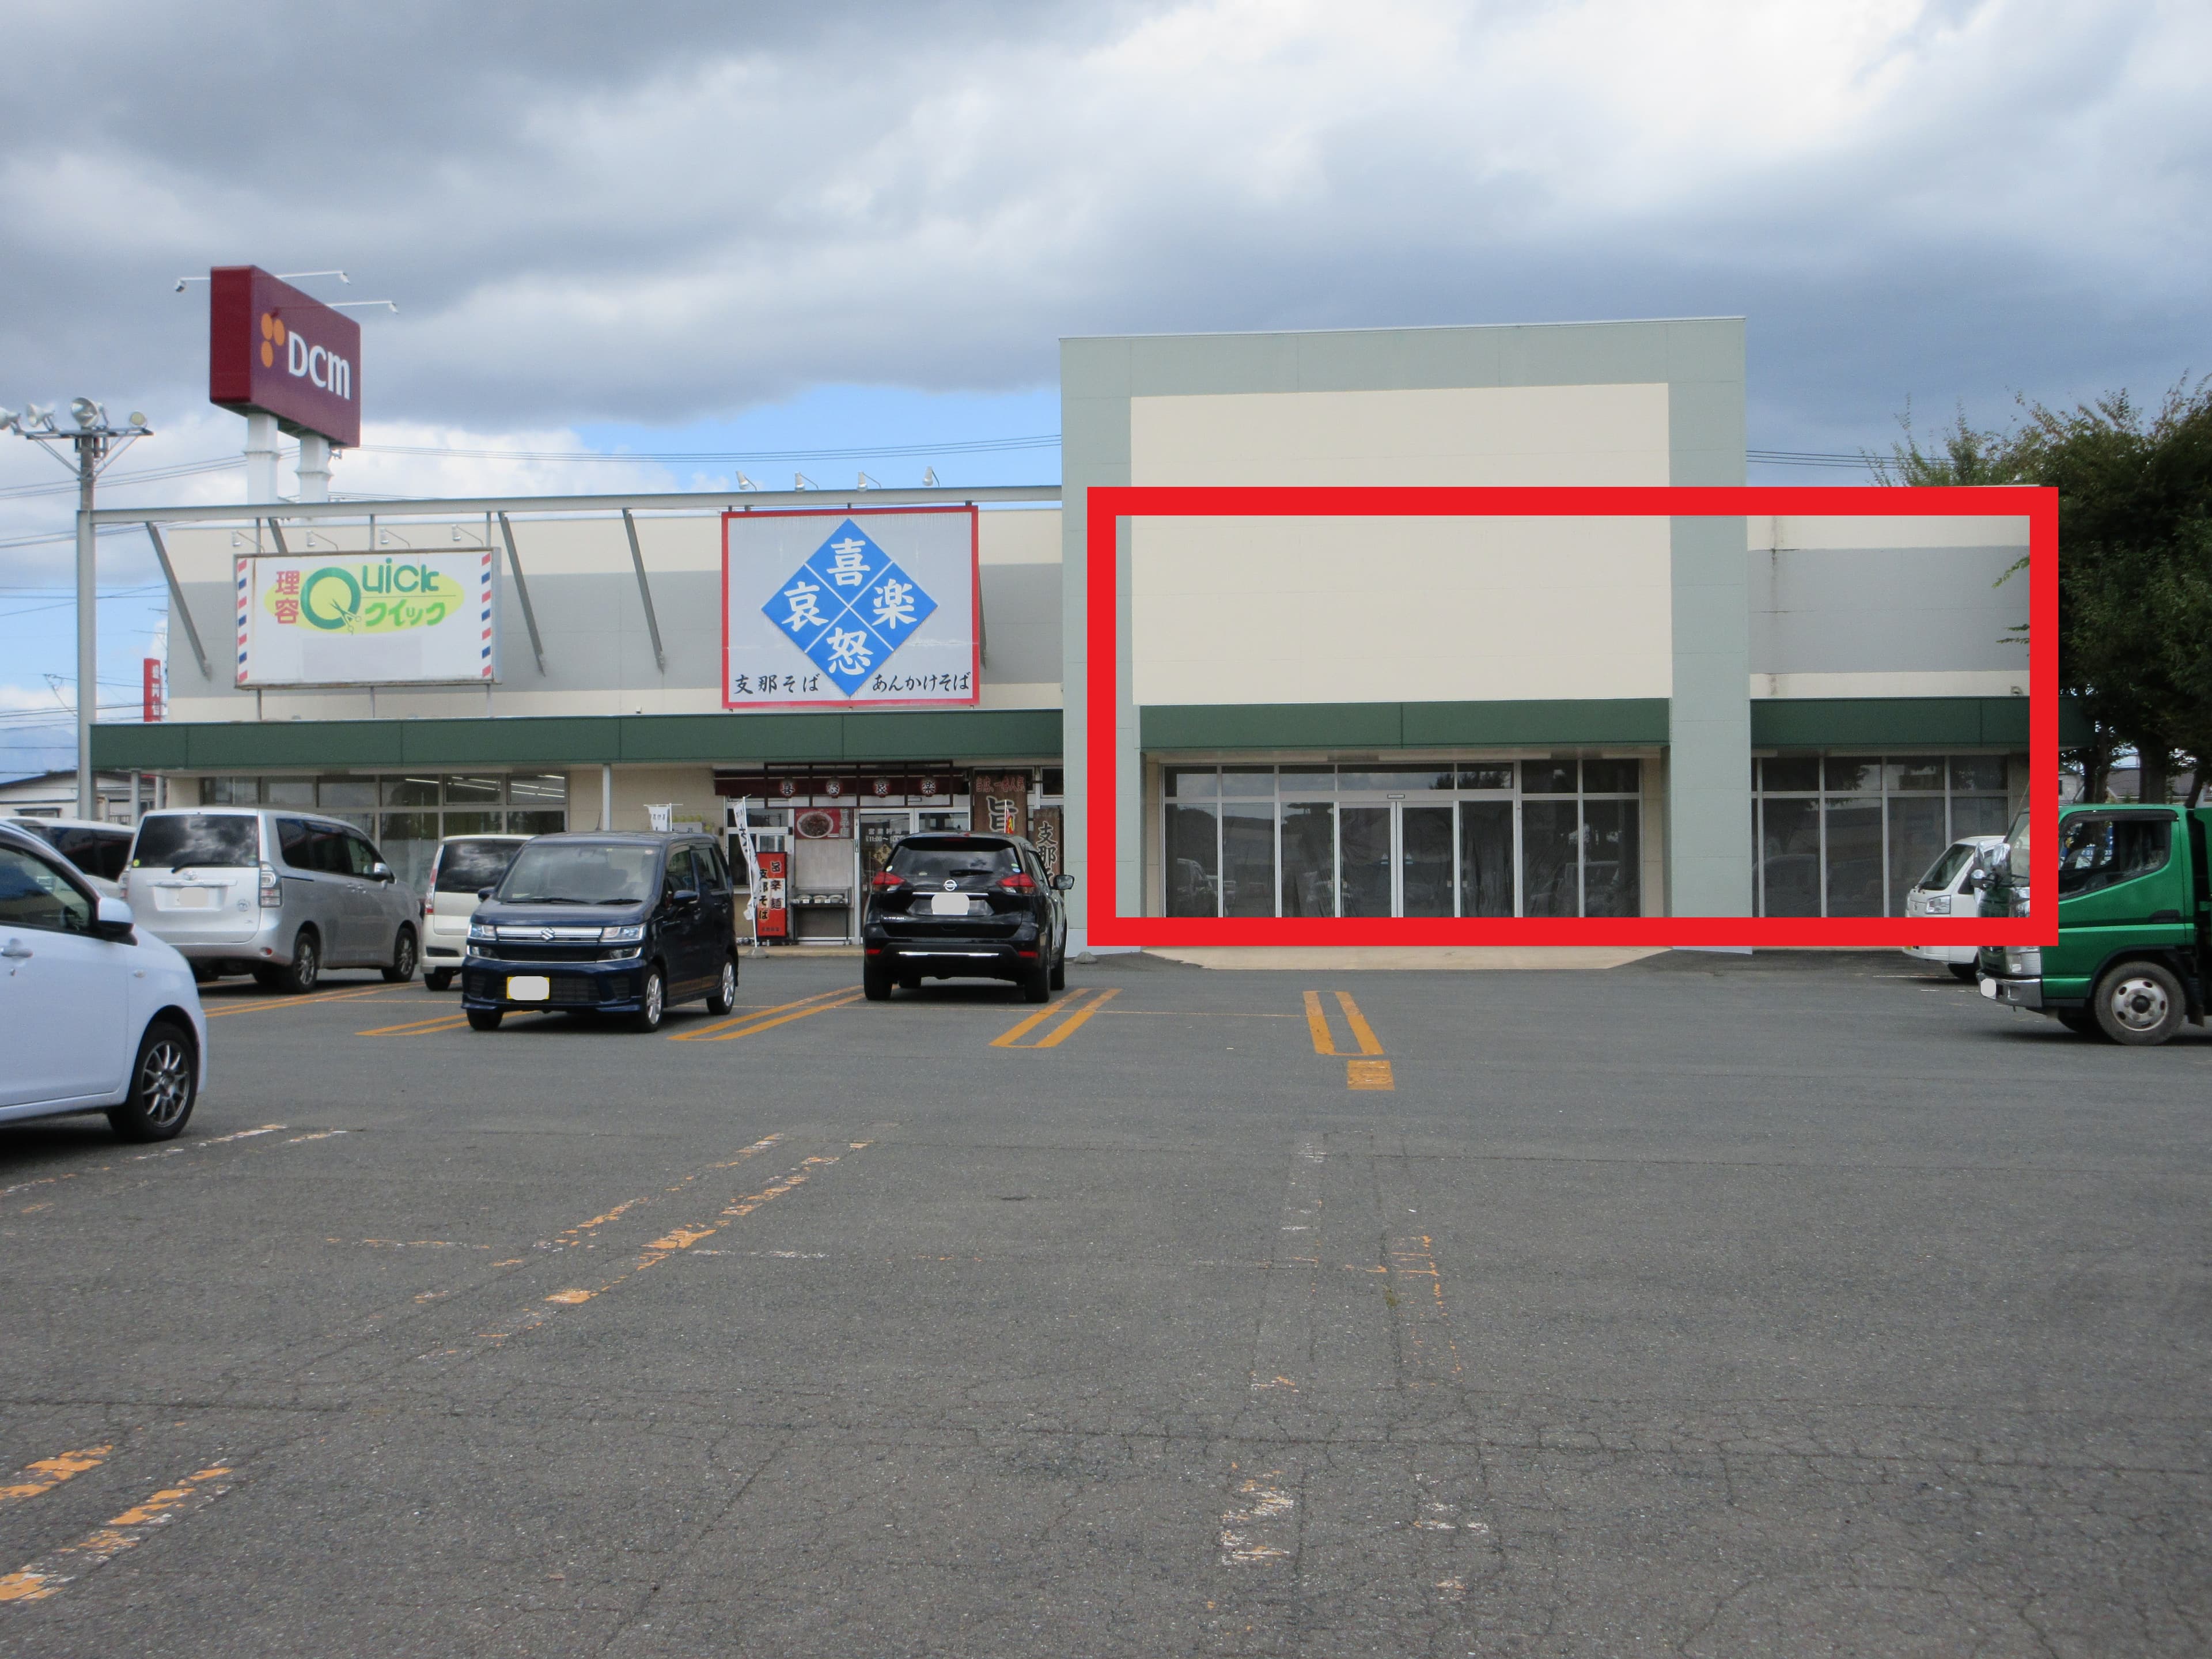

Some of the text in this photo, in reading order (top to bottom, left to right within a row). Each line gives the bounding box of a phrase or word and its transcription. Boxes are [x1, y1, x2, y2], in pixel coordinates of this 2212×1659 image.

[826, 537, 871, 587] 喜
[274, 570, 300, 624] 理容
[365, 599, 446, 627] クイック
[781, 581, 830, 632] 哀
[872, 578, 918, 629] 楽
[826, 627, 874, 676] 怒
[734, 673, 820, 695] 支那そば
[872, 672, 972, 692] あんかけそば
